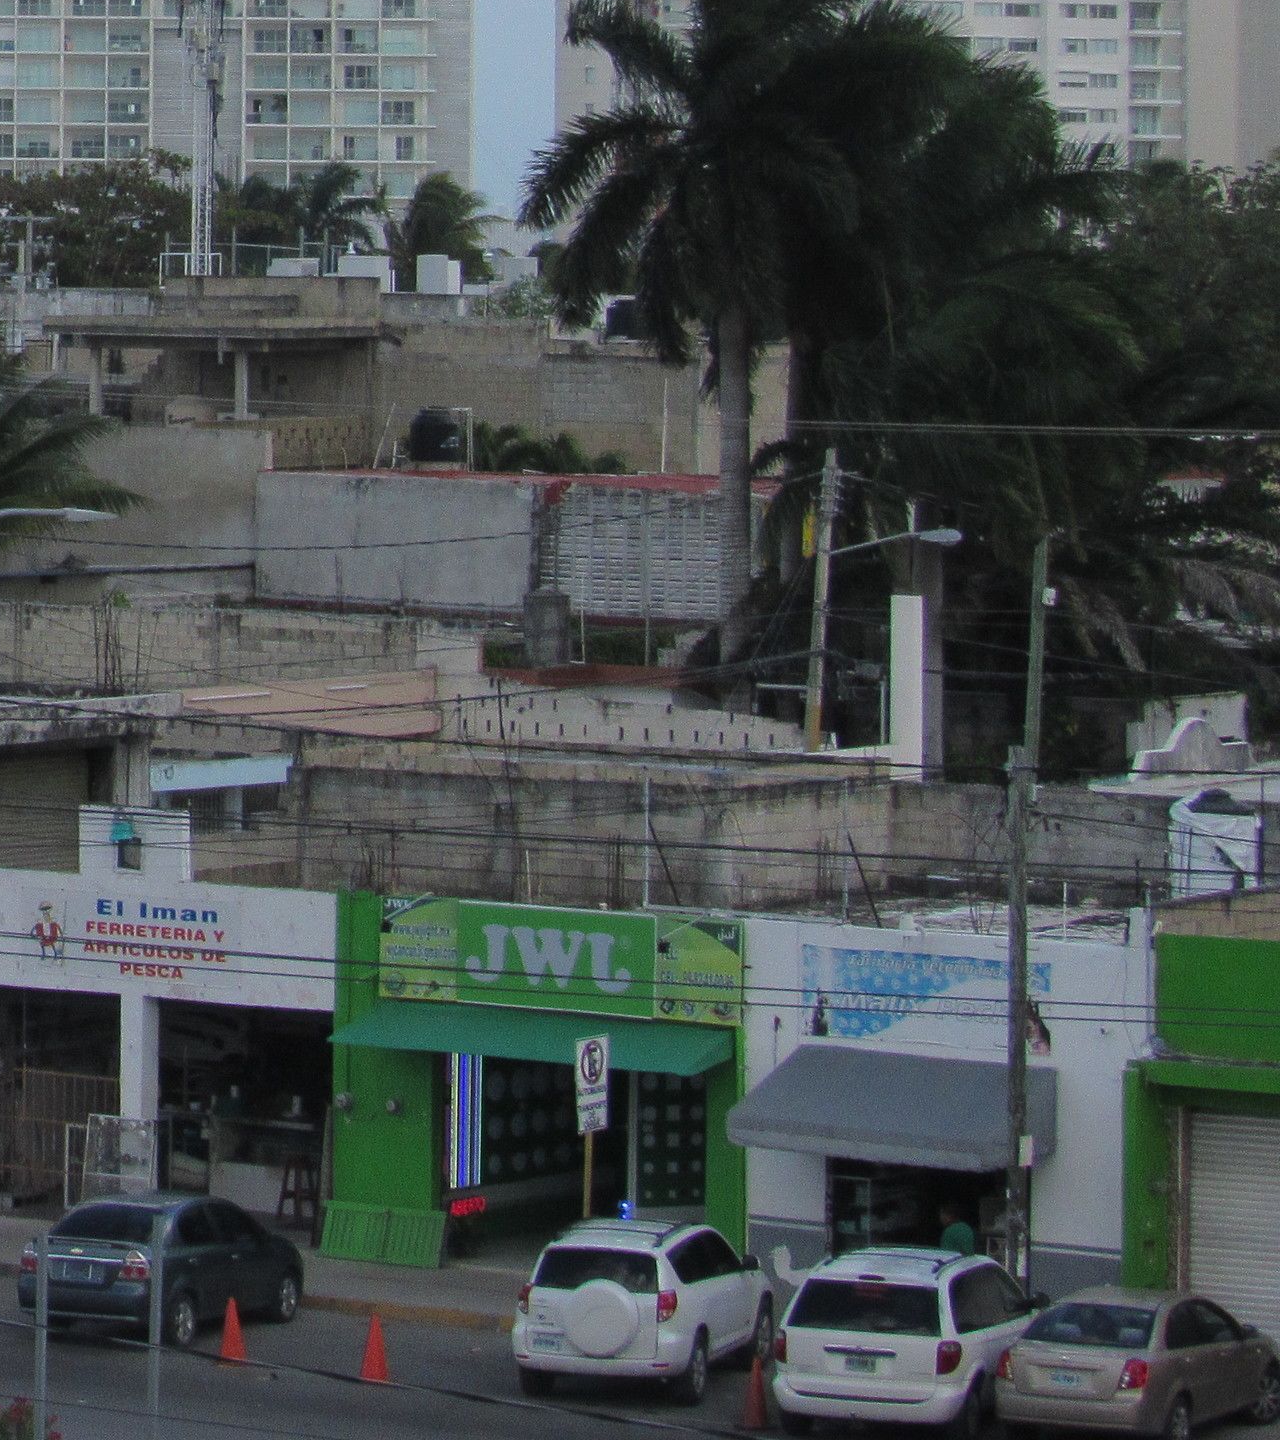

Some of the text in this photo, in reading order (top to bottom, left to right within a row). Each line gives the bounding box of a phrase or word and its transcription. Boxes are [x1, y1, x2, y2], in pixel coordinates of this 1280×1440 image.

[96, 898, 219, 924] El Iman
[85, 920, 226, 944] FERRETERIA Y
[83, 940, 227, 963] ARTICULOS DE
[464, 923, 632, 994] JWL
[119, 961, 184, 980] PESCA
